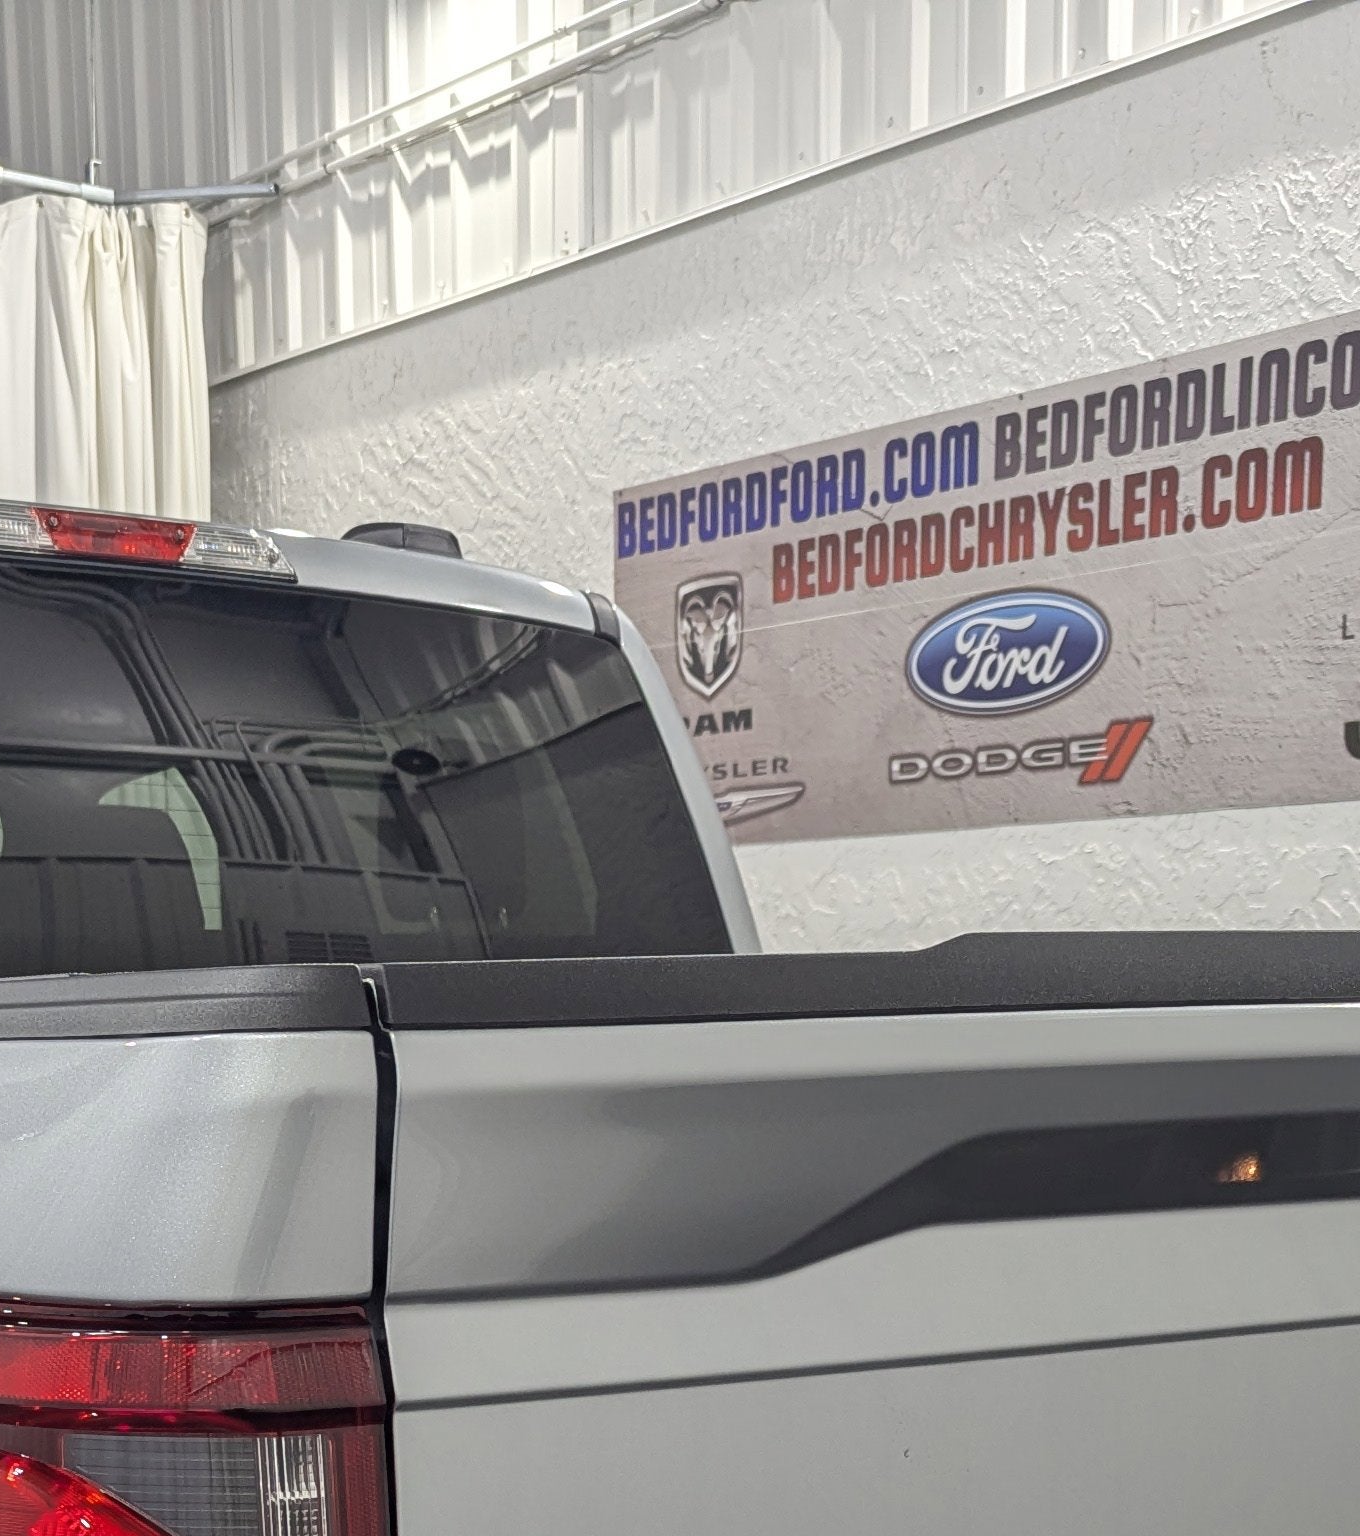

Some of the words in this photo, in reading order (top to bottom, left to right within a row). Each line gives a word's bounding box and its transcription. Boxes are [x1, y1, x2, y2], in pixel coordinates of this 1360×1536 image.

[617, 420, 979, 559] BEDFORDFORD.COM
[773, 435, 1324, 603] BEDFORDCHRYSLER.COM
[942, 613, 1069, 694] Ford
[890, 737, 1109, 782] DODGE
